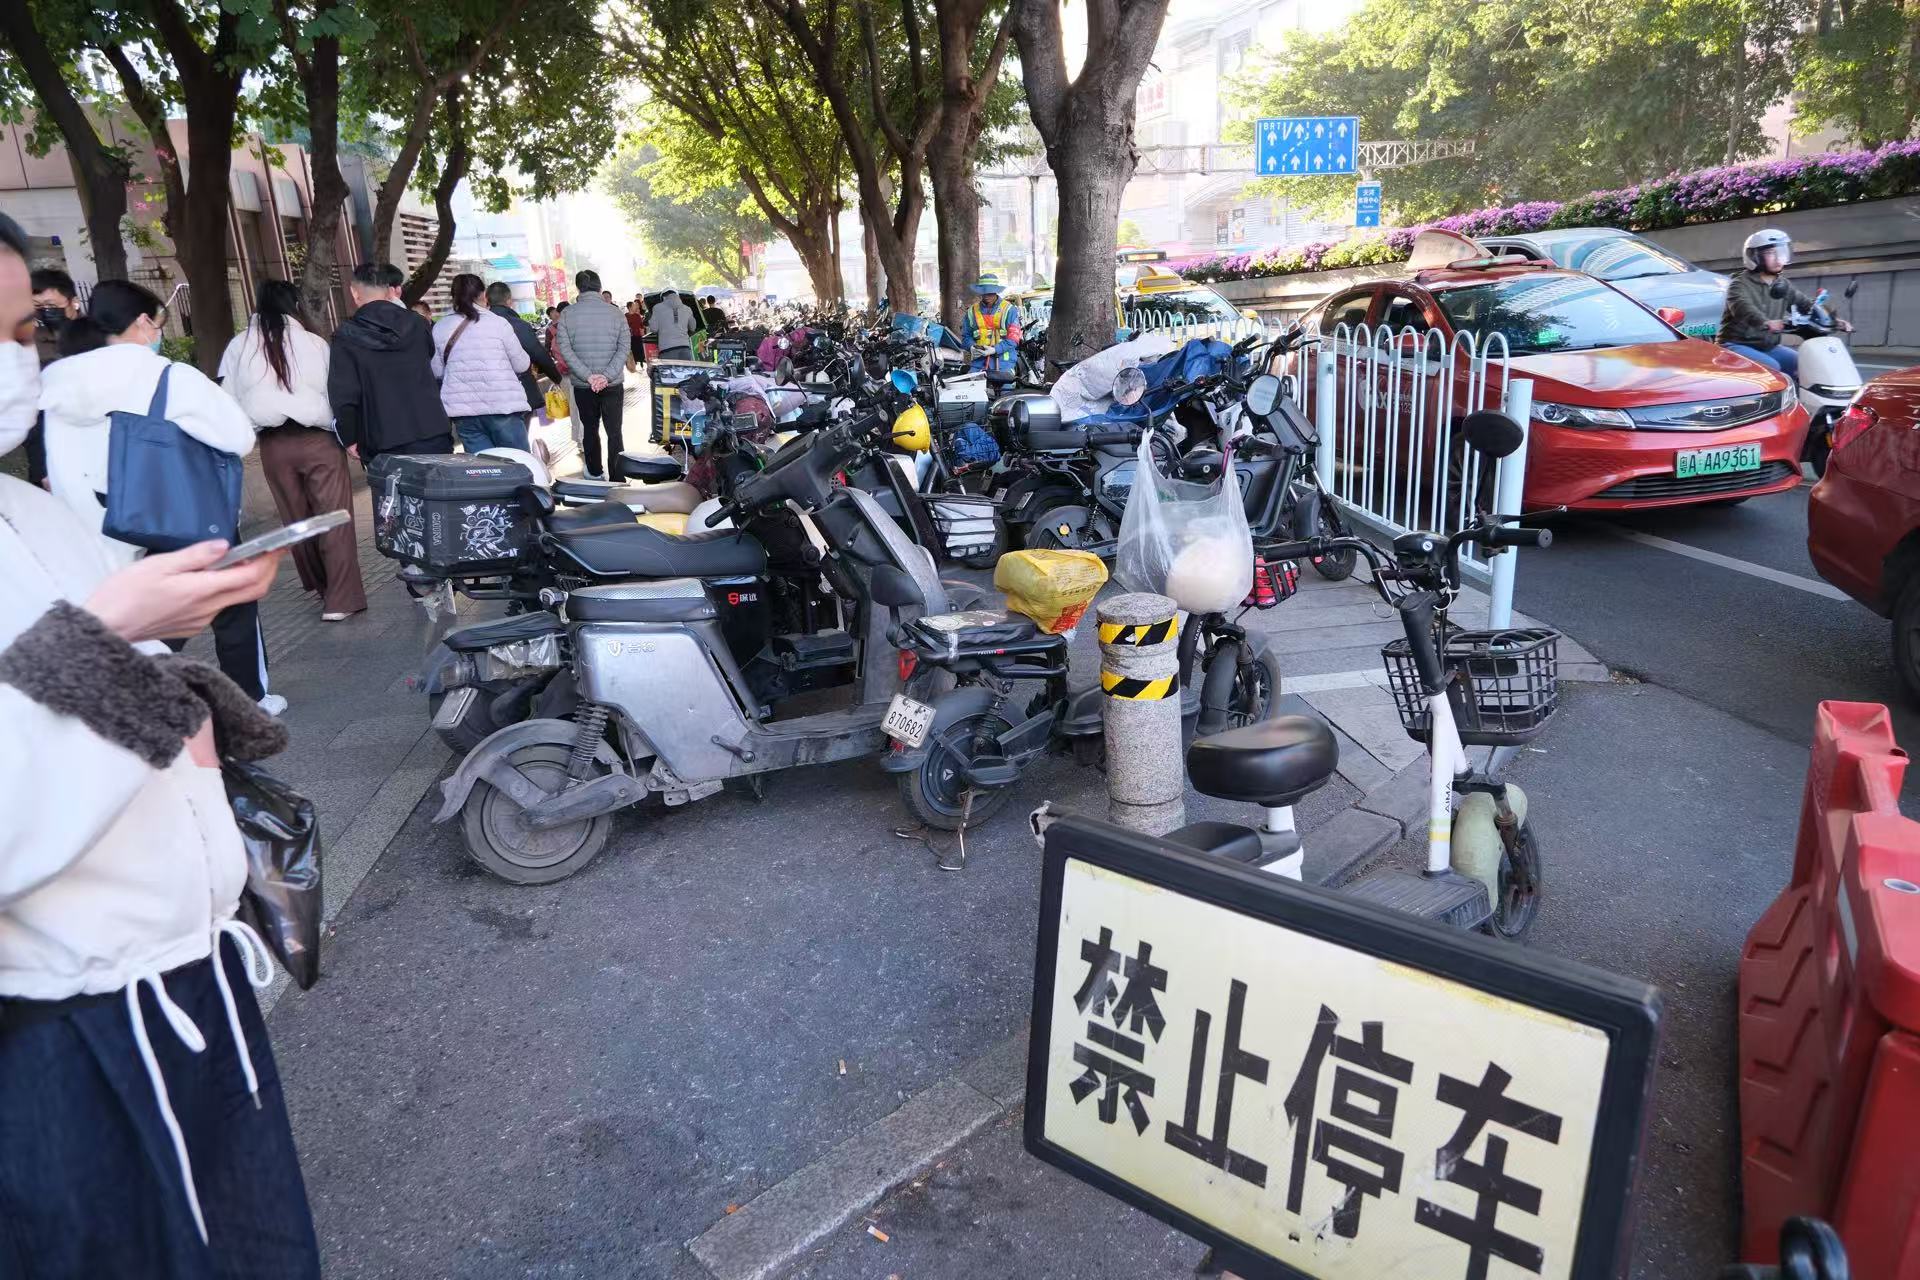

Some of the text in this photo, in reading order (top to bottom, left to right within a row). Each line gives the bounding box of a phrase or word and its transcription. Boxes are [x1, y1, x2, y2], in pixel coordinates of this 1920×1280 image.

[1263, 122, 1281, 130] BRT
[888, 711, 922, 738] 870682
[1069, 927, 1563, 1280] 禁止停车
